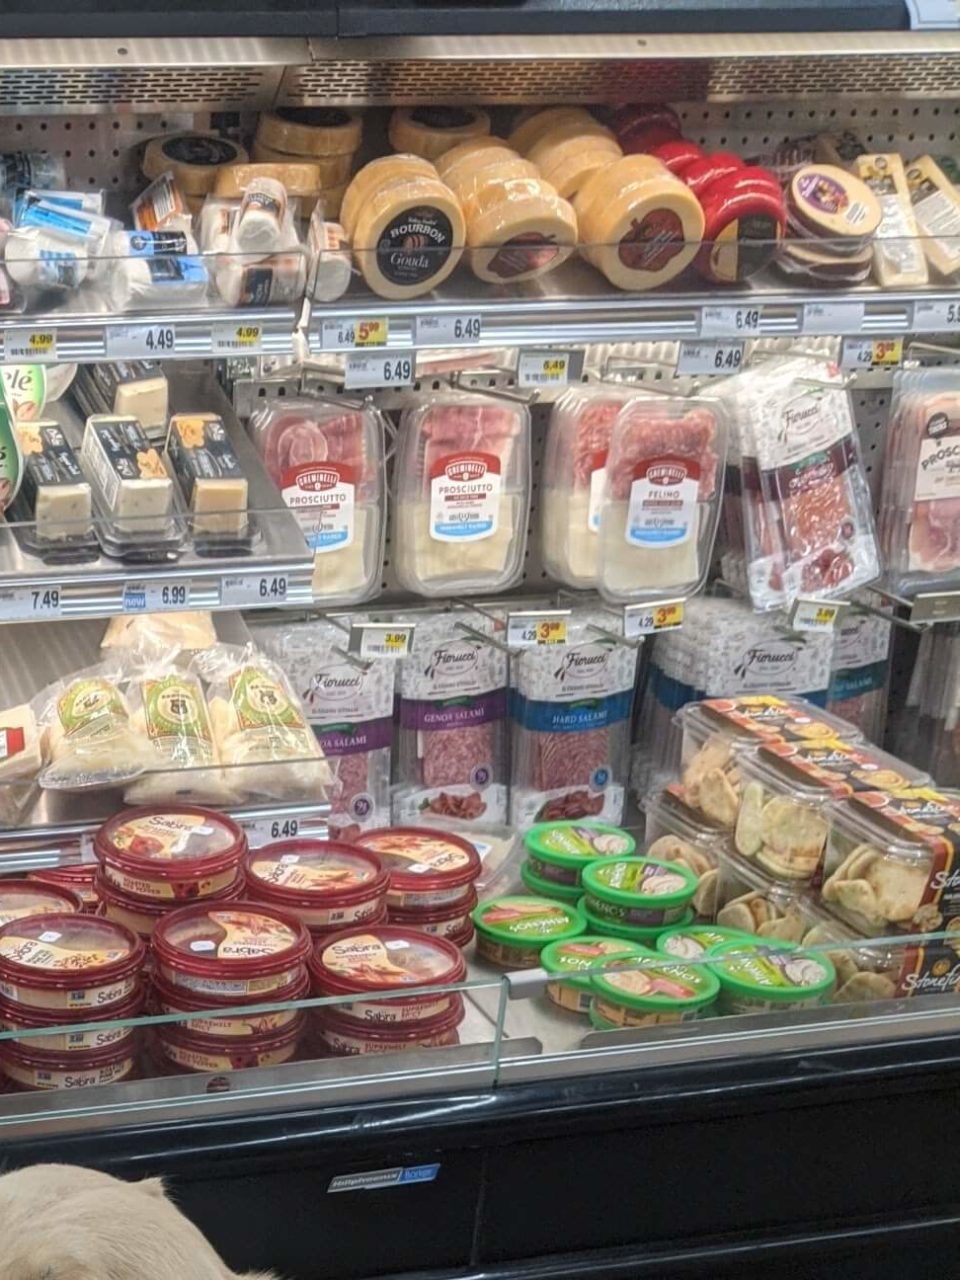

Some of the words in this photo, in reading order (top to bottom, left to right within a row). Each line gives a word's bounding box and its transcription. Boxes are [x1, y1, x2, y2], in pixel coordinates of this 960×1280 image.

[390, 223, 445, 243] BOURBON
[390, 252, 429, 268] Gouda
[736, 310, 759, 329] 6.49
[454, 318, 481, 339] 6.49
[146, 328, 174, 351] 4.49
[714, 349, 741, 369] 6.49
[383, 360, 411, 381] 6.49
[438, 483, 494, 495] PROSCIUTTO
[289, 493, 346, 505] PROSCIUTTO
[162, 585, 186, 605] 6.99
[259, 577, 287, 597] 6.49
[31, 590, 59, 610] 7.49
[434, 649, 475, 666] Fiorucci
[566, 652, 606, 669] Fiorucci
[748, 649, 795, 665] Fiorucci
[455, 706, 485, 720] SALAMI
[551, 714, 577, 725] HARD
[334, 735, 367, 748] SALAMI
[271, 818, 298, 838] 6.49
[331, 943, 381, 955] Sabra
[97, 985, 122, 1005] Sabra
[364, 1009, 396, 1022] Sabra
[95, 1029, 122, 1046] Sabra
[64, 1075, 96, 1089] Sabra
